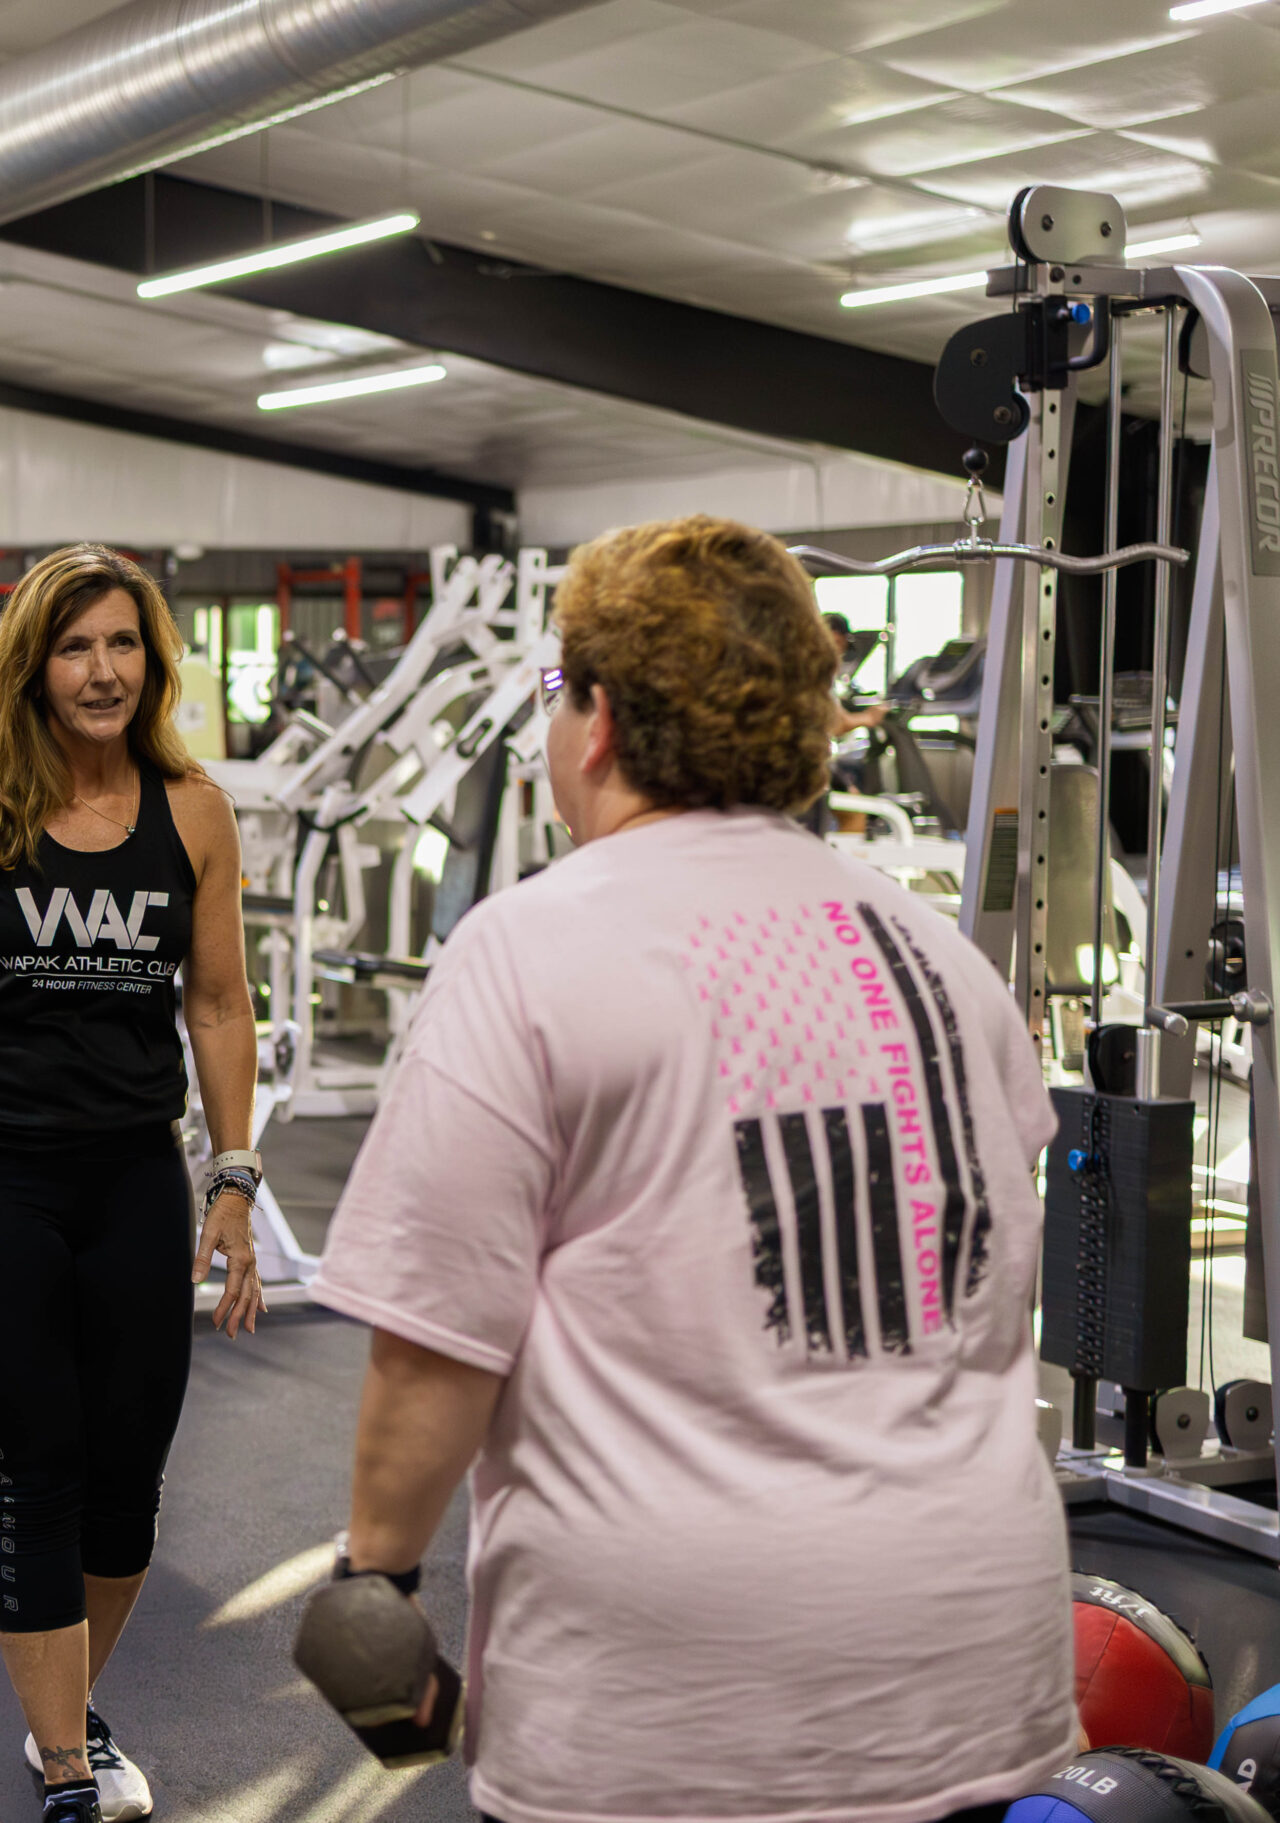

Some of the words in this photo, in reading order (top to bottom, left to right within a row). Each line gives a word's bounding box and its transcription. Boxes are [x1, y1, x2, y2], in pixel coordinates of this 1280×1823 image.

[1250, 398, 1280, 551] PRECOR
[15, 887, 169, 951] WAC
[32, 979, 44, 988] 24
[46, 980, 76, 990] HOUR
[77, 981, 115, 991] FITNESS
[117, 982, 152, 994] CENTER
[64, 956, 144, 973] ATHLETIC
[147, 960, 176, 976] CLUB
[822, 901, 862, 946] NO
[851, 957, 900, 1031] ONE
[879, 1043, 931, 1186] FIGHTS
[909, 1199, 943, 1336] ALONE
[1051, 1766, 1118, 1795] 20LB
